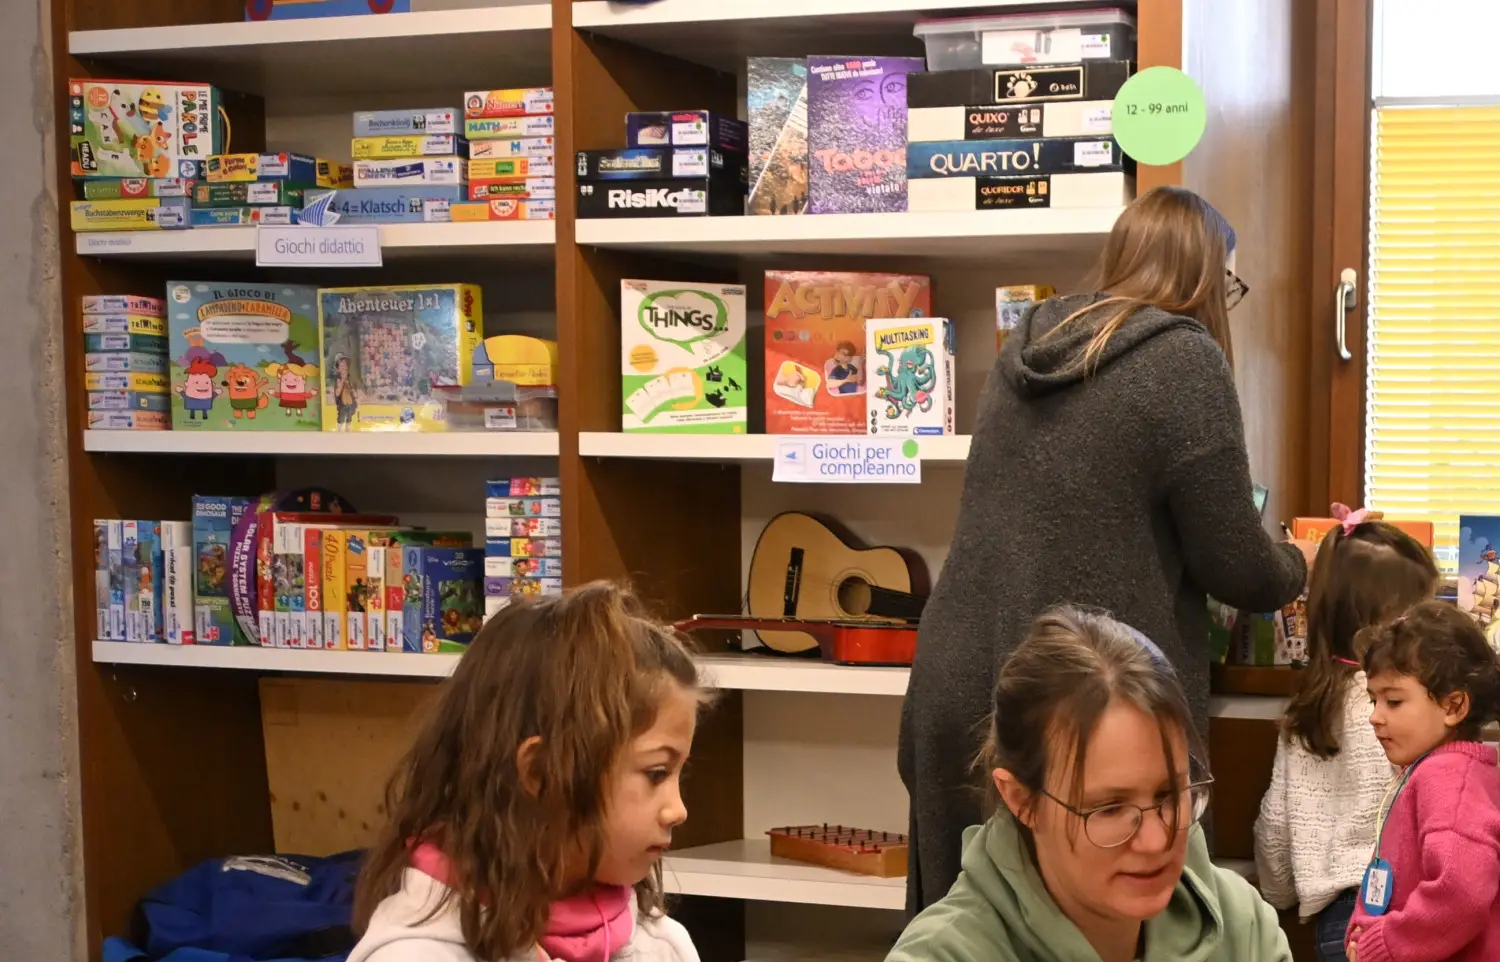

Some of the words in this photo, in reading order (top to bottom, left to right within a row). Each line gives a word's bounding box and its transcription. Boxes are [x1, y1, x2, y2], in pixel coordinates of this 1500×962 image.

[969, 112, 1008, 125] QUIXO
[1126, 105, 1138, 115] 12
[1148, 103, 1163, 114] 99
[1165, 102, 1189, 114] anni
[181, 90, 199, 157] PAROLE
[929, 142, 1041, 176] QUARTO!
[274, 237, 315, 255] Giochi
[318, 237, 364, 255] didattici
[227, 288, 261, 299] GIOCO
[766, 279, 921, 320] ACTIVITY
[338, 295, 415, 314] Abenteuer
[879, 328, 930, 346] MULTITASKING
[811, 442, 861, 460] Giochi
[866, 446, 893, 465] per
[819, 457, 917, 480] compleanno
[205, 503, 227, 511] GOOD
[242, 522, 258, 555] SOLAR
[324, 533, 339, 553] 40
[239, 554, 250, 596] SYSTEM
[307, 585, 320, 610] 100
